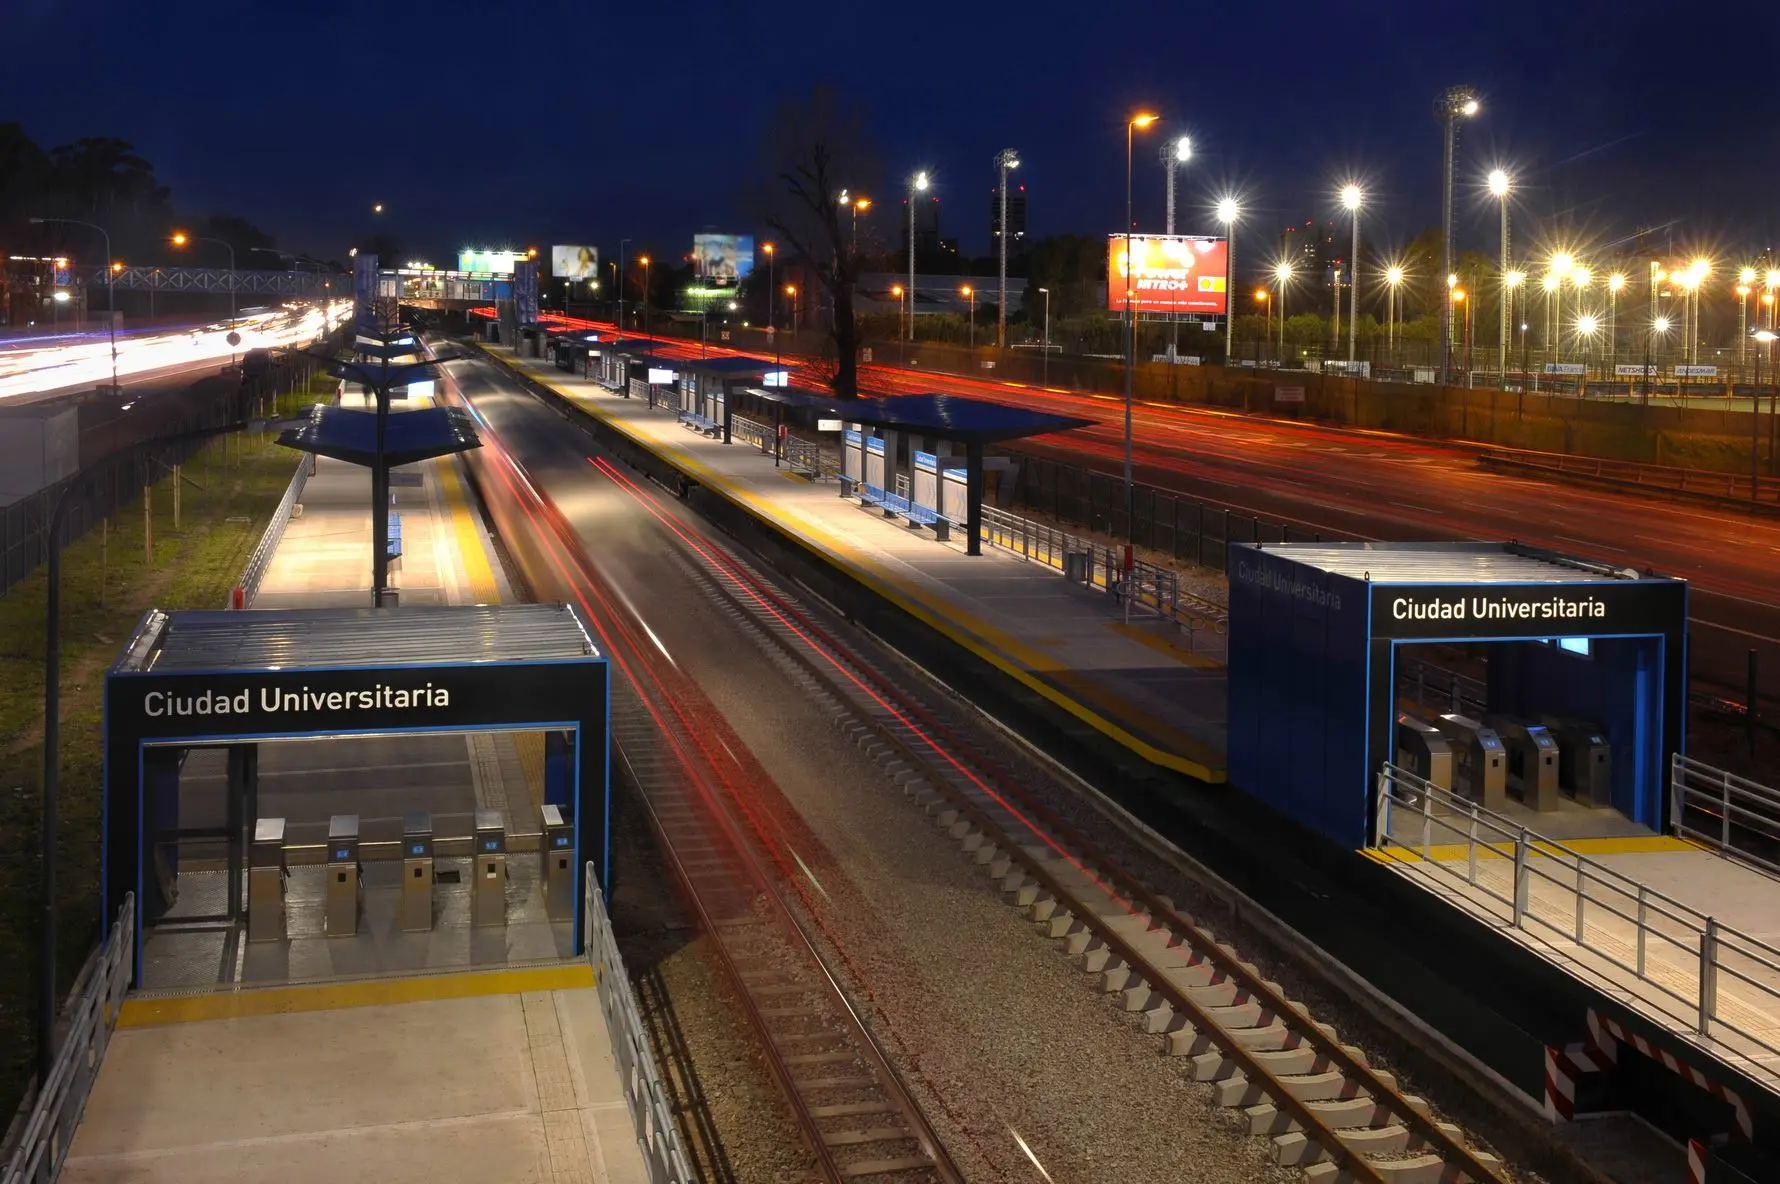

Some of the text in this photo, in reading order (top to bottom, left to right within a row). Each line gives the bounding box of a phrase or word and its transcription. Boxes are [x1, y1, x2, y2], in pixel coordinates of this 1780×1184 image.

[1239, 561, 1341, 610] Ciudad Universitaria
[1392, 596, 1605, 620] Ciudad Universitaria
[144, 682, 450, 717] Ciudad Universitaria
